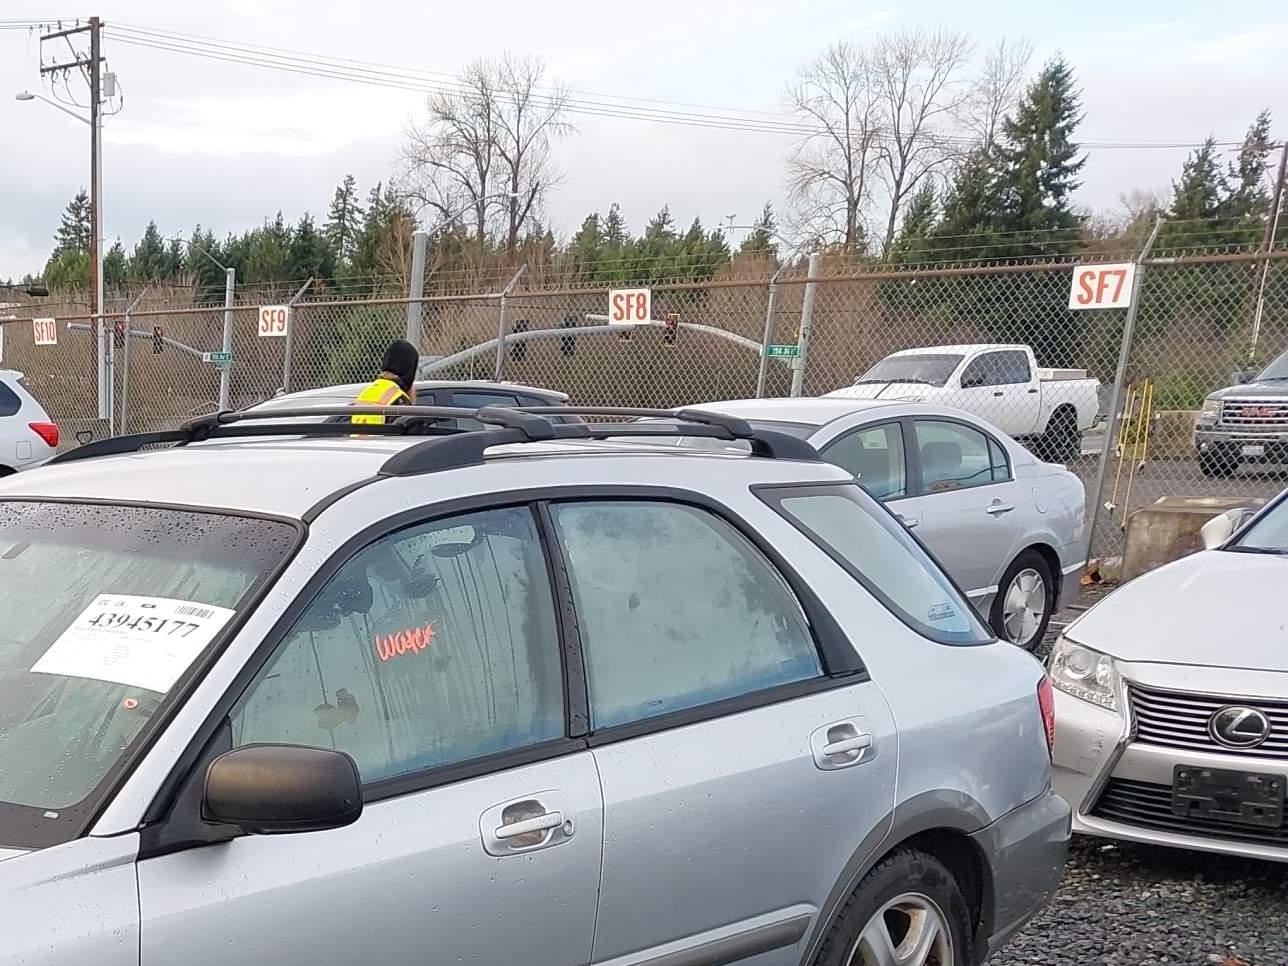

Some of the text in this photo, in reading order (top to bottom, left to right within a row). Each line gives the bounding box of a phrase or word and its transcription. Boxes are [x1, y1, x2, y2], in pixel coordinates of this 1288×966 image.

[1077, 269, 1127, 305] SF7
[612, 292, 647, 321] SF8
[34, 321, 56, 342] SF10
[261, 309, 286, 333] SF9
[88, 611, 201, 639] 43945177
